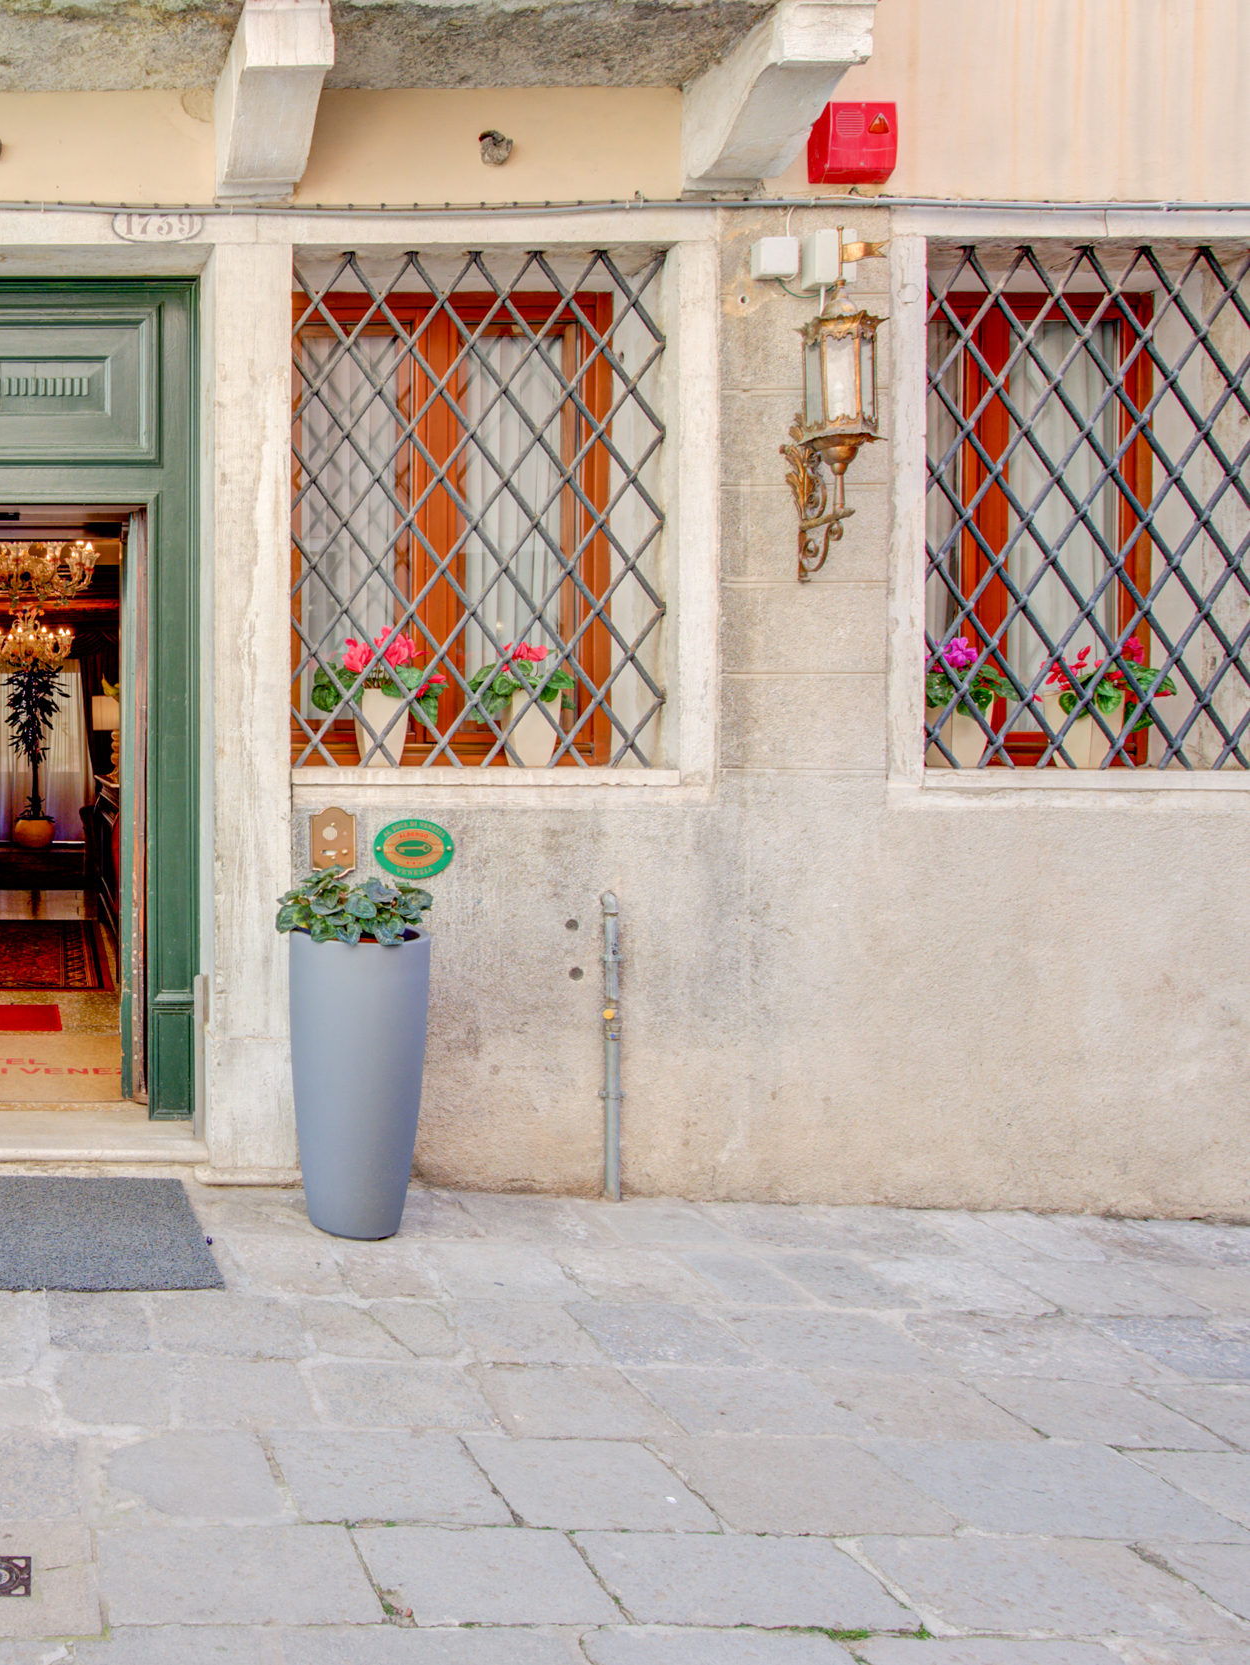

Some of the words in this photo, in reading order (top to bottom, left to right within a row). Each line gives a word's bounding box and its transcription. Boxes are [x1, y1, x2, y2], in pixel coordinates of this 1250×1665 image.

[125, 213, 195, 236] 1739
[383, 829, 392, 838] AL
[391, 822, 408, 831] DUCA
[420, 822, 446, 838] VENEZIA
[396, 867, 433, 876] VENEZIA
